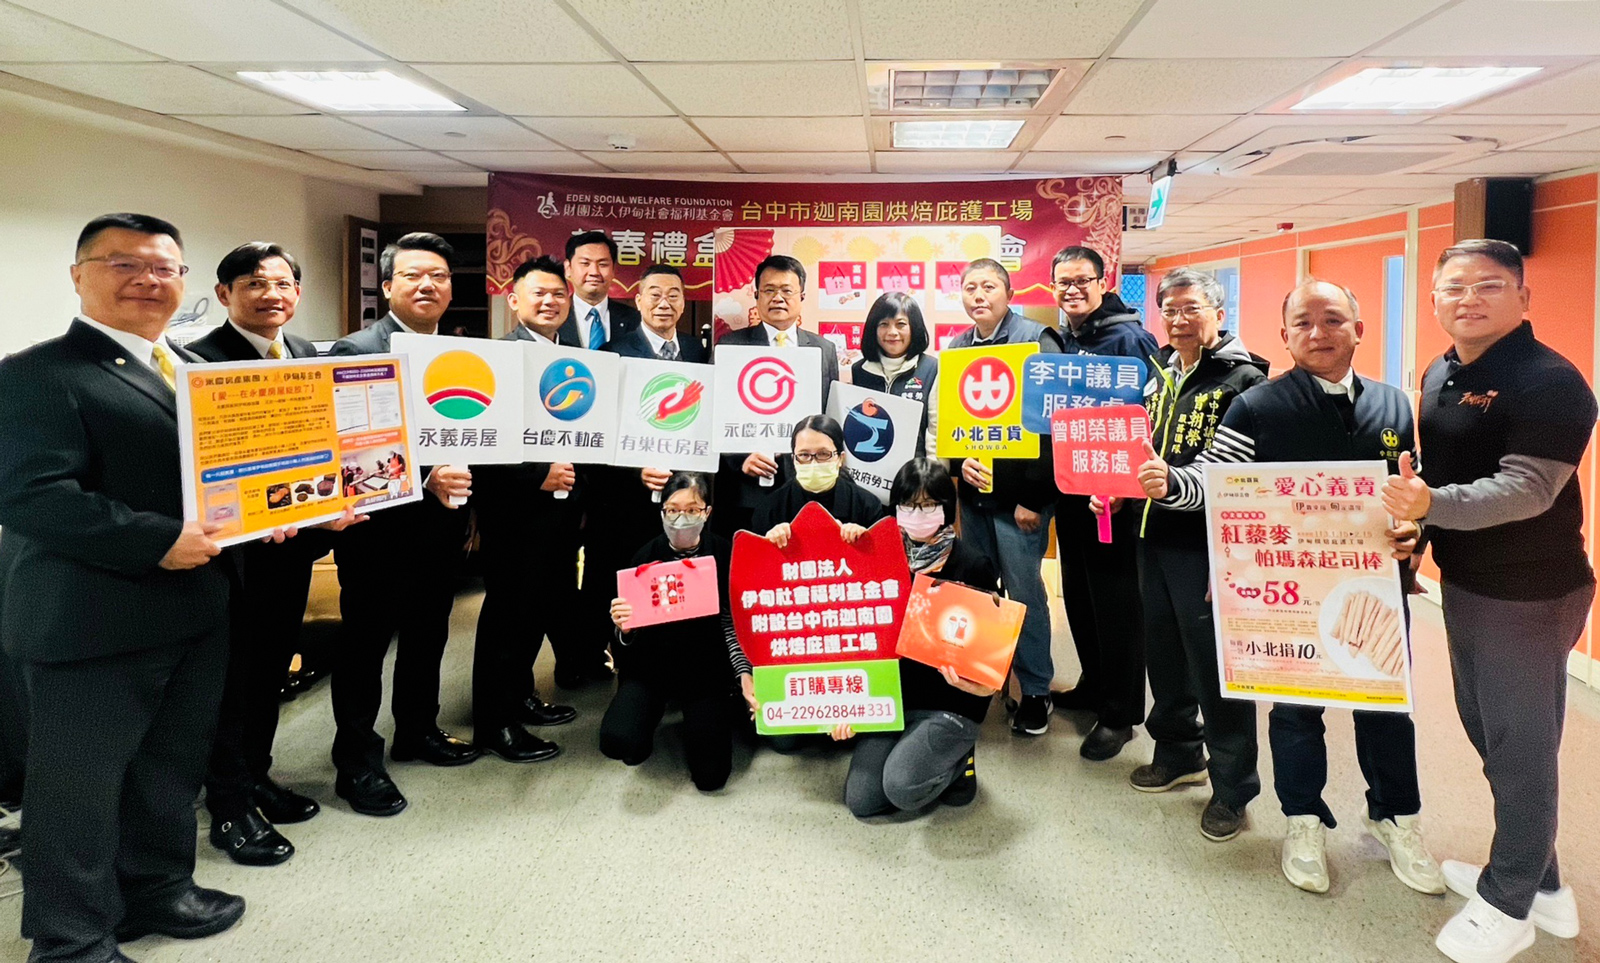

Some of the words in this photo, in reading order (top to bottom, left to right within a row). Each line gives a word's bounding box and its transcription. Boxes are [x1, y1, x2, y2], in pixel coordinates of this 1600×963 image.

[566, 194, 591, 203] EDEN
[593, 195, 627, 204] SOCIAL
[629, 196, 672, 206] WELFARE
[674, 197, 733, 207] FOUNDATION
[741, 199, 1034, 223] 台中市迦南園烘焙庇護工場
[563, 204, 735, 222] 財團法人伊甸社會福利基金會
[572, 228, 715, 268] 春禮盒
[1029, 360, 1141, 391] 李中議員
[1053, 416, 1150, 443] 曾朝榮議員
[1185, 392, 1208, 448] 曾朝榮
[418, 427, 498, 449] 永義房屋
[522, 427, 606, 450] 台慶不動產
[951, 425, 1022, 443] 小北百貨
[620, 434, 710, 458] 有巢氏房屋
[964, 443, 1009, 451] SHOWBA
[1072, 450, 1131, 475] 服務處
[846, 467, 893, 490] 政府勞工
[1274, 475, 1377, 498] 愛心義賣
[1220, 523, 1292, 545] 紅藜麥
[781, 557, 853, 582] 財團法人
[1254, 549, 1384, 570] 帕瑪森起司棒
[741, 579, 900, 608] 伊甸社會福利基金會
[1262, 580, 1300, 606] 58
[751, 605, 894, 633] 附設台中市迦南園
[770, 632, 878, 657] 烘焙庇護工場
[789, 674, 865, 697] 訂購專線
[766, 702, 893, 722] 04-22962884#331
